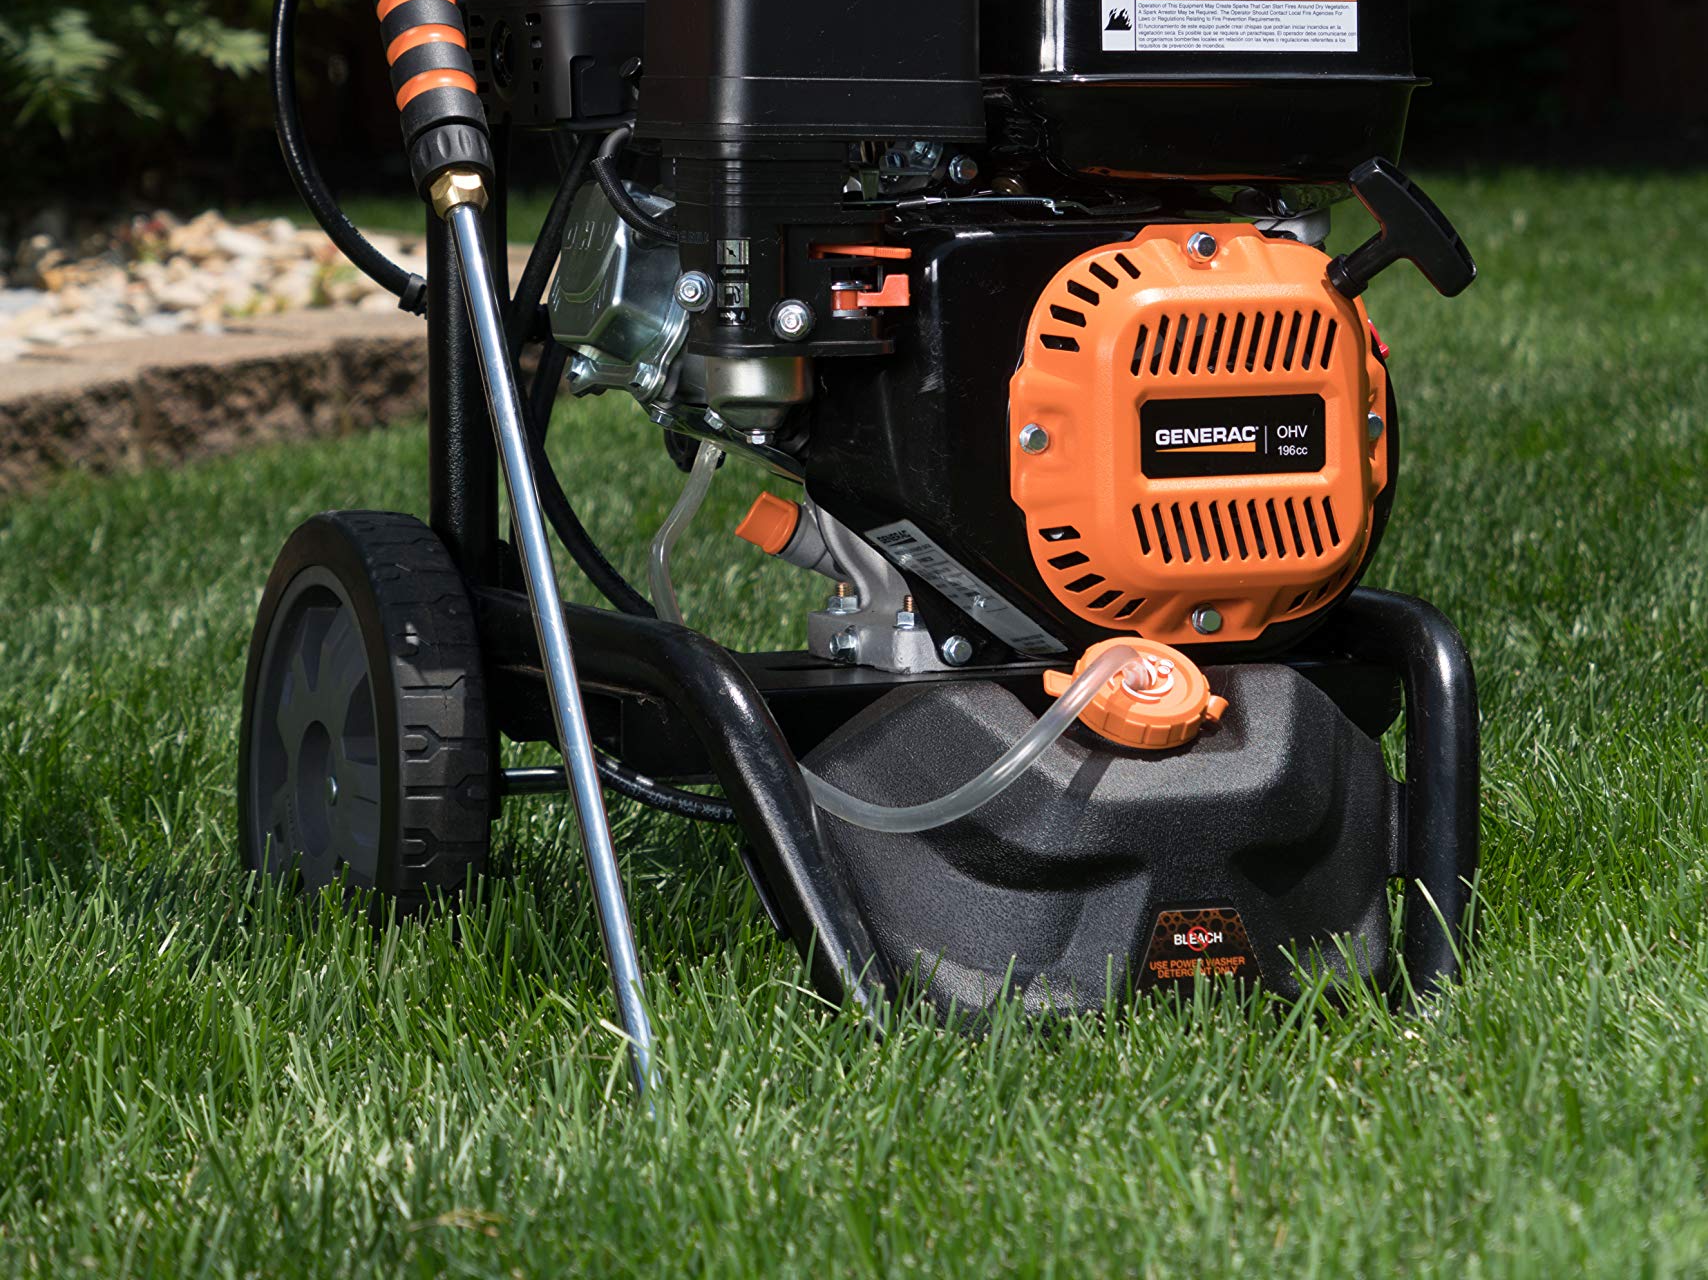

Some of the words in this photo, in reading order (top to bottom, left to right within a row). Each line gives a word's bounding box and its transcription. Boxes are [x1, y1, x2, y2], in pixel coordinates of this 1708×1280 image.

[1155, 426, 1256, 445] GENERAC
[1276, 424, 1308, 438] OHV
[1278, 445, 1308, 456] 196cc
[1174, 932, 1223, 946] BLEACH
[1150, 960, 1168, 970] USE
[1206, 956, 1245, 966] WASHER
[1158, 966, 1211, 978] DETERGNT
